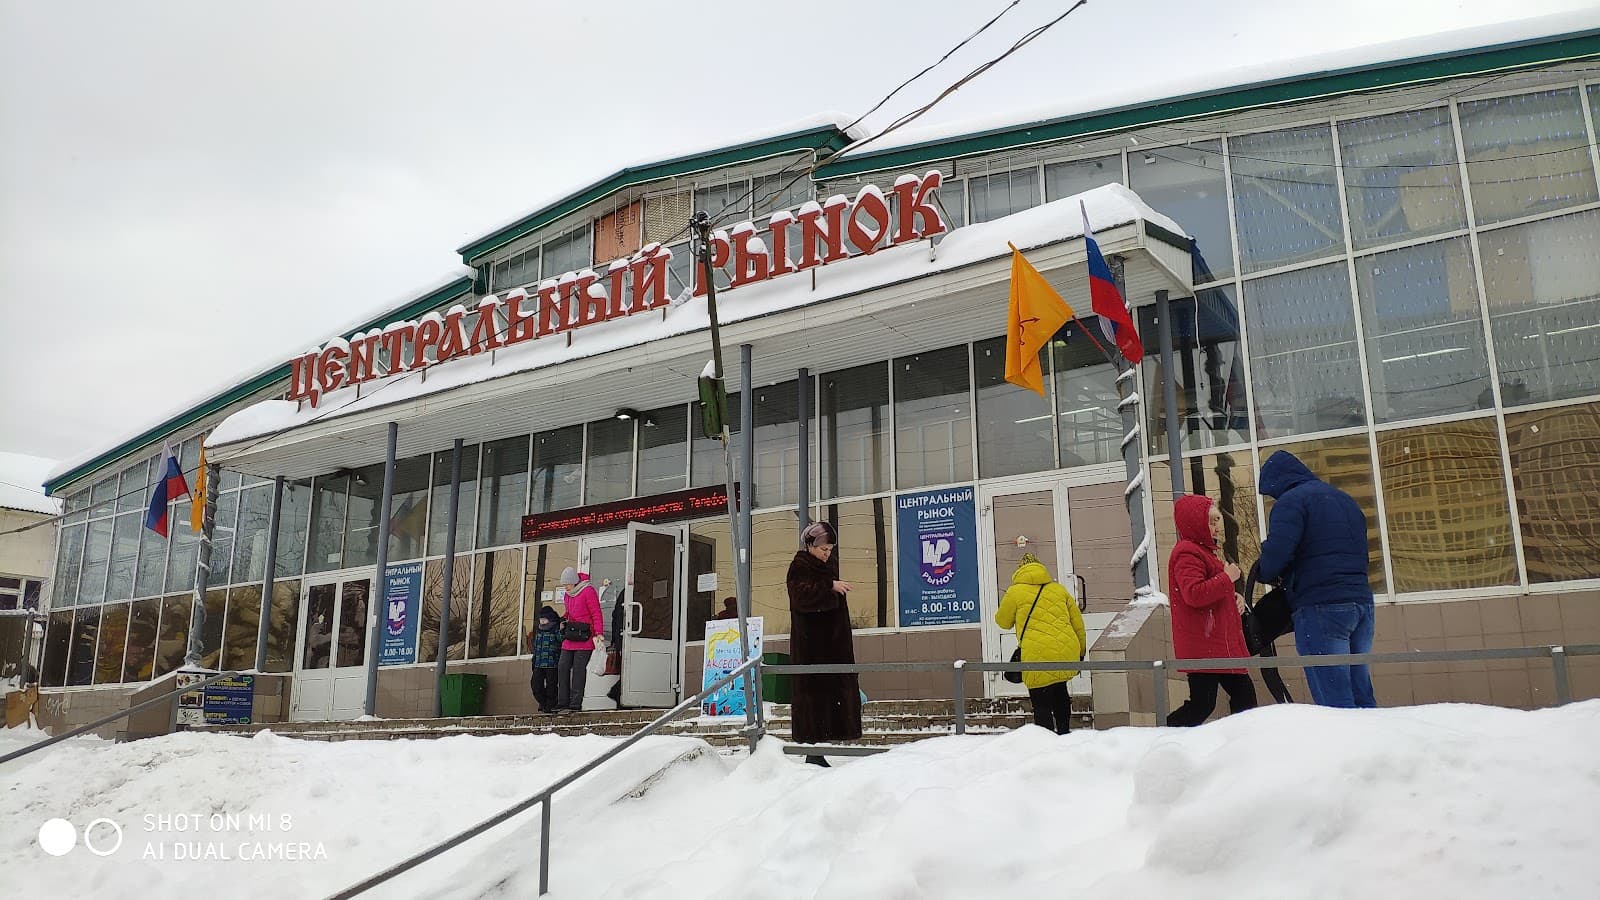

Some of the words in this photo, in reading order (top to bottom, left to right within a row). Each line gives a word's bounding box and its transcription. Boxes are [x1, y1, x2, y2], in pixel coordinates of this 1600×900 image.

[288, 246, 673, 407] ЦЕНТРАЛЬНЫЙ
[693, 172, 945, 296] РЫНОК
[900, 489, 972, 508] ЦЕНТРАЛЬНЫЙ
[917, 507, 954, 520] РЫНОК
[919, 531, 954, 540] ЦЕНТРАЛЬНЫЙ
[385, 564, 421, 576] ЕНТРАЛЬНЫЙ
[389, 577, 411, 586] РЫНОК
[922, 569, 955, 585] РЫНОК
[922, 601, 975, 613] 8.00-18.00
